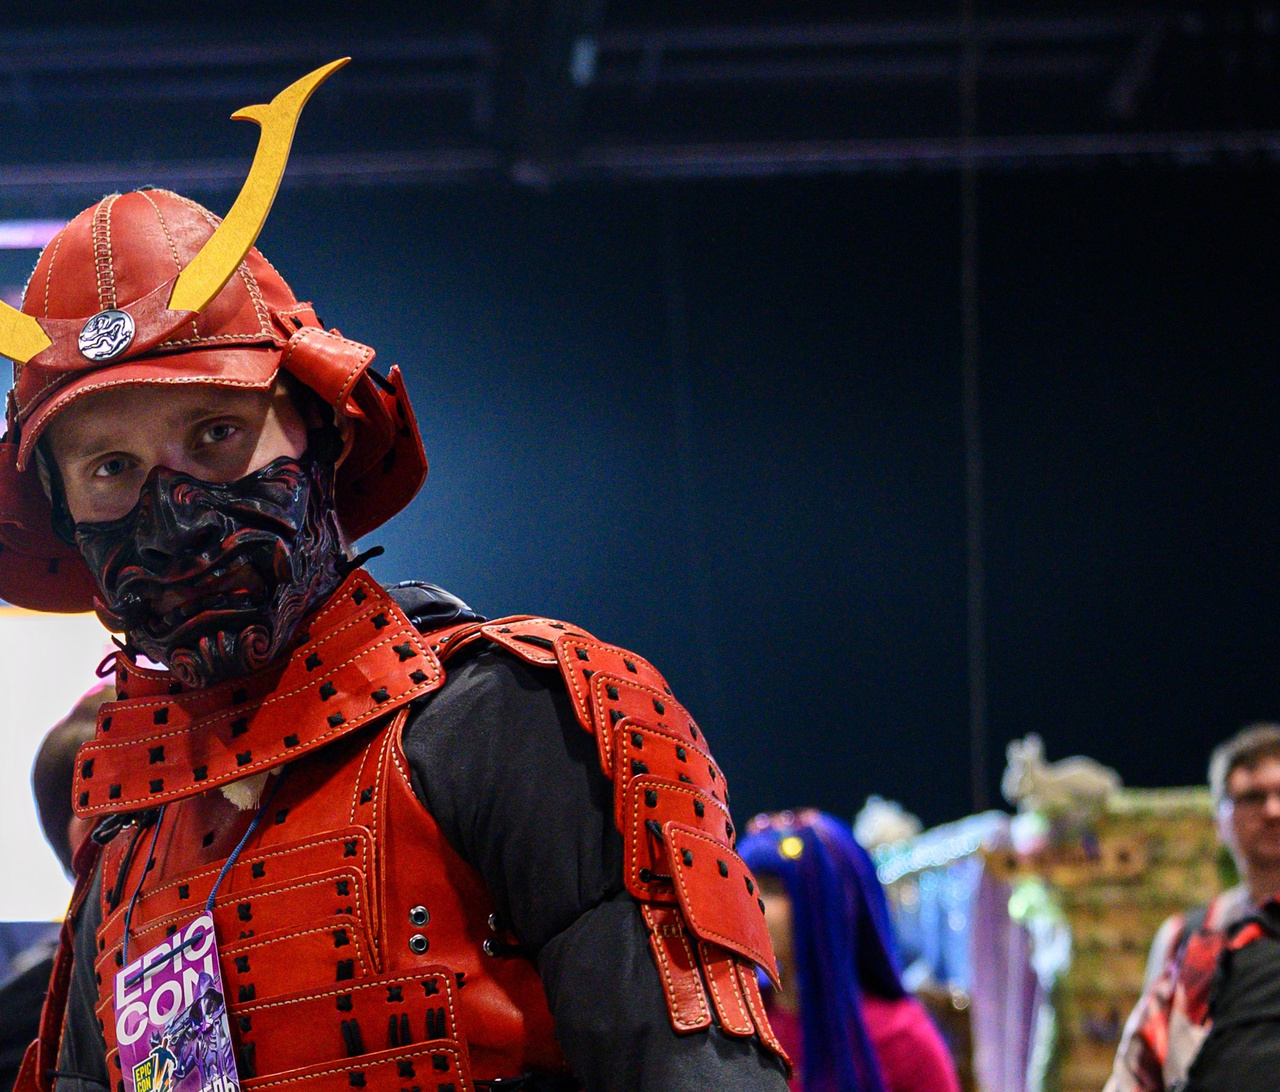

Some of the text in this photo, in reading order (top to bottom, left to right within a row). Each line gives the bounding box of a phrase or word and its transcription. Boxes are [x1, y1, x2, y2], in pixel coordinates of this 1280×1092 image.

[116, 915, 215, 1010] EPIC
[116, 953, 215, 1046] CON
[135, 1061, 152, 1082] EPIC
